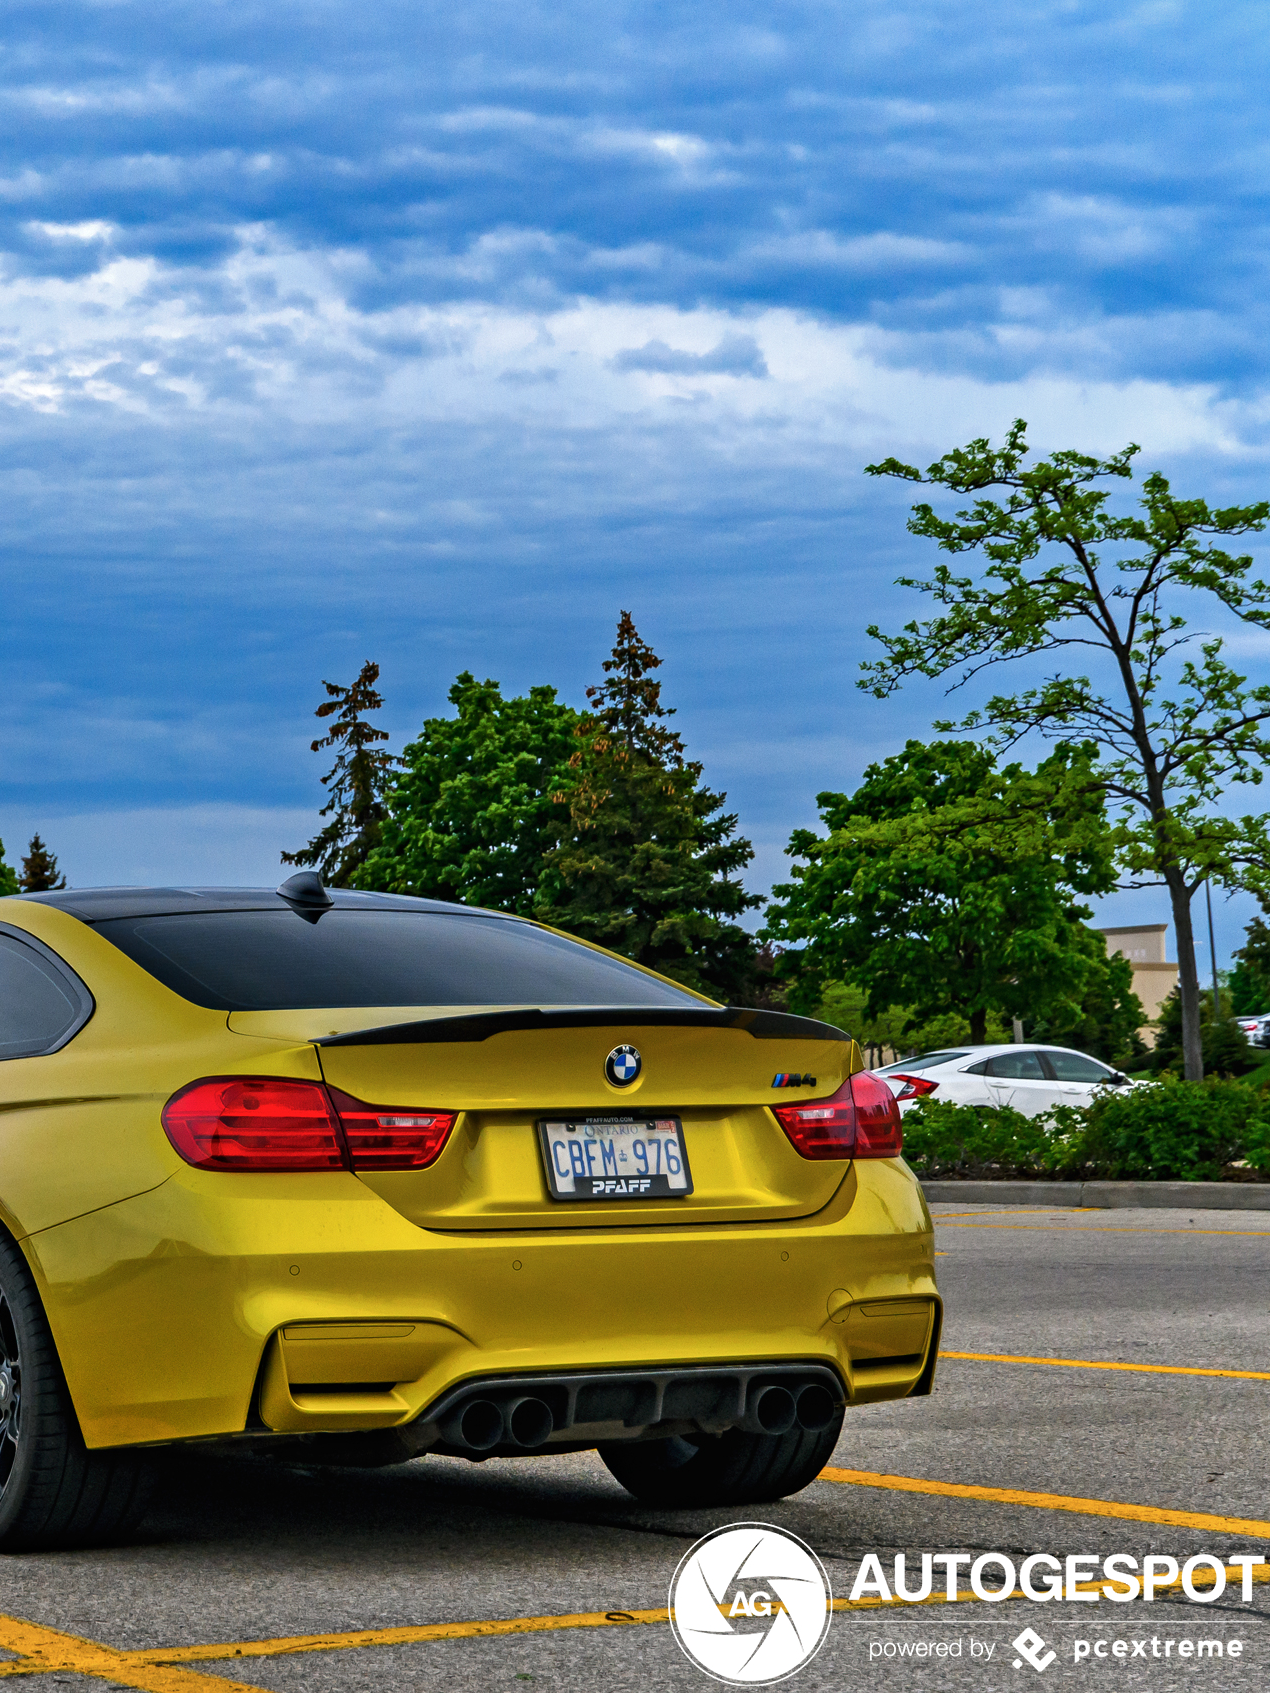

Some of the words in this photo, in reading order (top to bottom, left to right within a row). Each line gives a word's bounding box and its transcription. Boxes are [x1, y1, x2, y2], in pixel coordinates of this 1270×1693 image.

[553, 1139, 619, 1178] CBFM
[632, 1139, 681, 1176] 976
[592, 1179, 651, 1194] PFAFF
